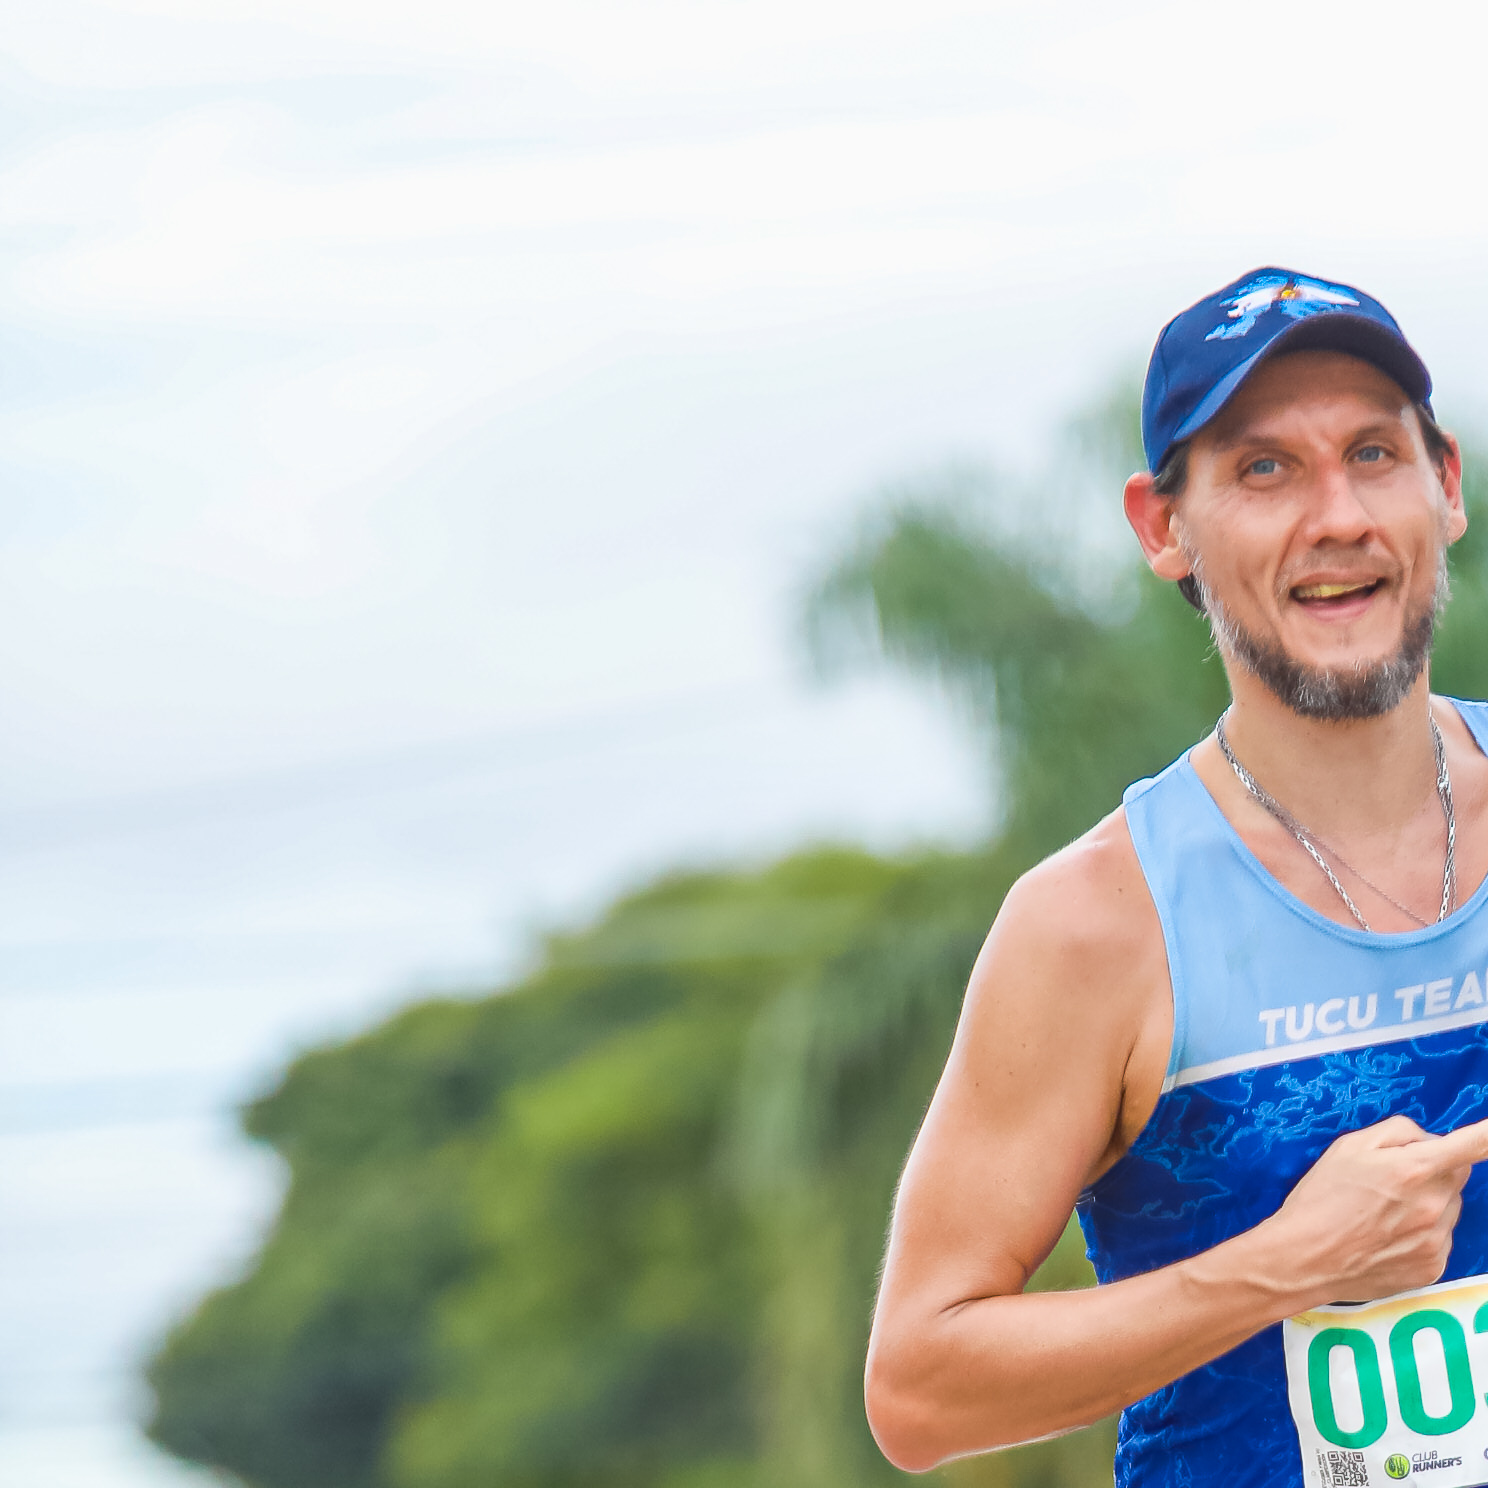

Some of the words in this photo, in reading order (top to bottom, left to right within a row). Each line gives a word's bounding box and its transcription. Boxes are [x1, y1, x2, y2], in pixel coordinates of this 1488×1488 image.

[1258, 993, 1378, 1045] TUCU
[1412, 1450, 1438, 1463] CLUB
[1412, 1456, 1463, 1473] RUNNER'S
